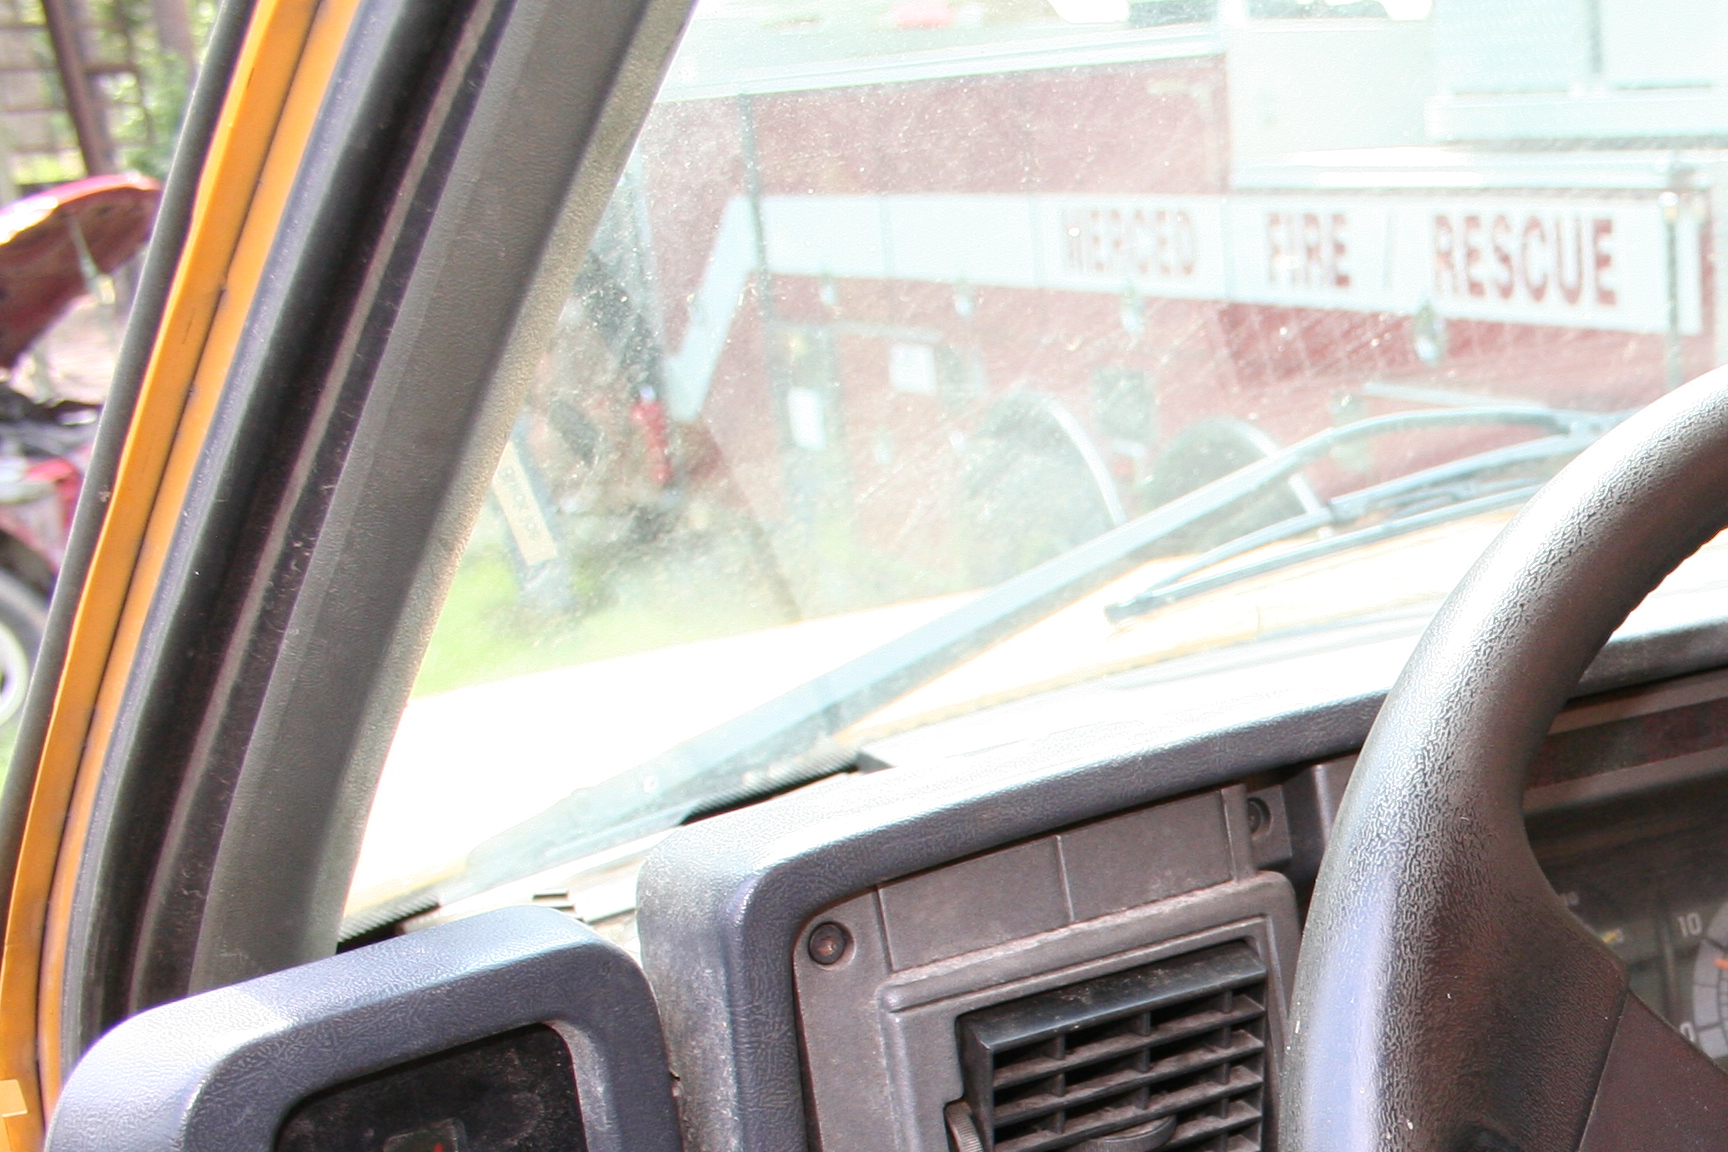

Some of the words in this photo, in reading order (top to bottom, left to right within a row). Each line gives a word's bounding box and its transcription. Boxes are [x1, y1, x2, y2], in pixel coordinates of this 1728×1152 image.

[1062, 207, 1198, 278] MERCED
[1266, 210, 1352, 289] FIRE
[1432, 213, 1618, 306] RESCUE
[1677, 911, 1702, 939] 10
